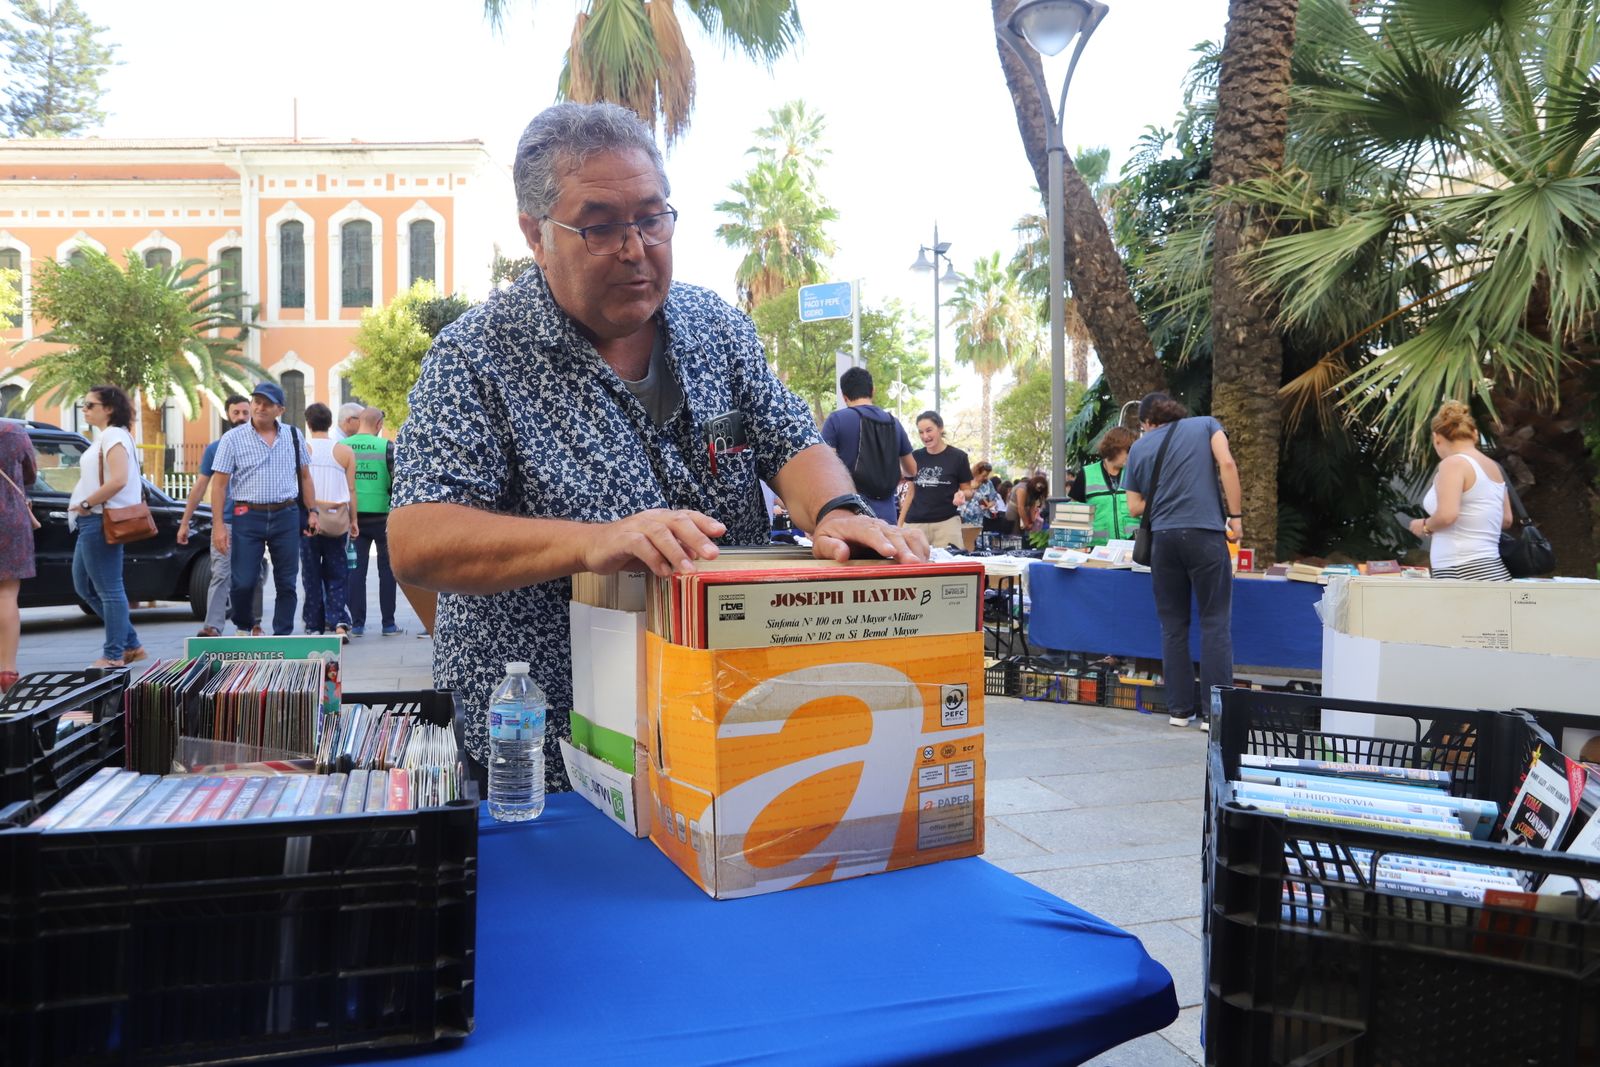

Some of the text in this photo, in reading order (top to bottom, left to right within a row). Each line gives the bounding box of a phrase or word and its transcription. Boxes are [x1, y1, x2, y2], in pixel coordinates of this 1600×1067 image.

[350, 443, 377, 451] DICAL
[770, 587, 917, 607] JOSEPH HAYDN
[920, 589, 932, 606] B
[721, 603, 743, 611] rtve
[815, 616, 830, 626] 100
[845, 615, 859, 625] Sol
[860, 614, 886, 625] Mayor
[818, 631, 832, 641] 102
[848, 629, 858, 639] Si
[863, 627, 889, 638] Bemol
[893, 627, 919, 637] Mayor
[945, 710, 964, 718] PEFC
[938, 795, 970, 808] PAPER
[1523, 794, 1542, 813] TOMA
[1529, 811, 1551, 839] DINERO
